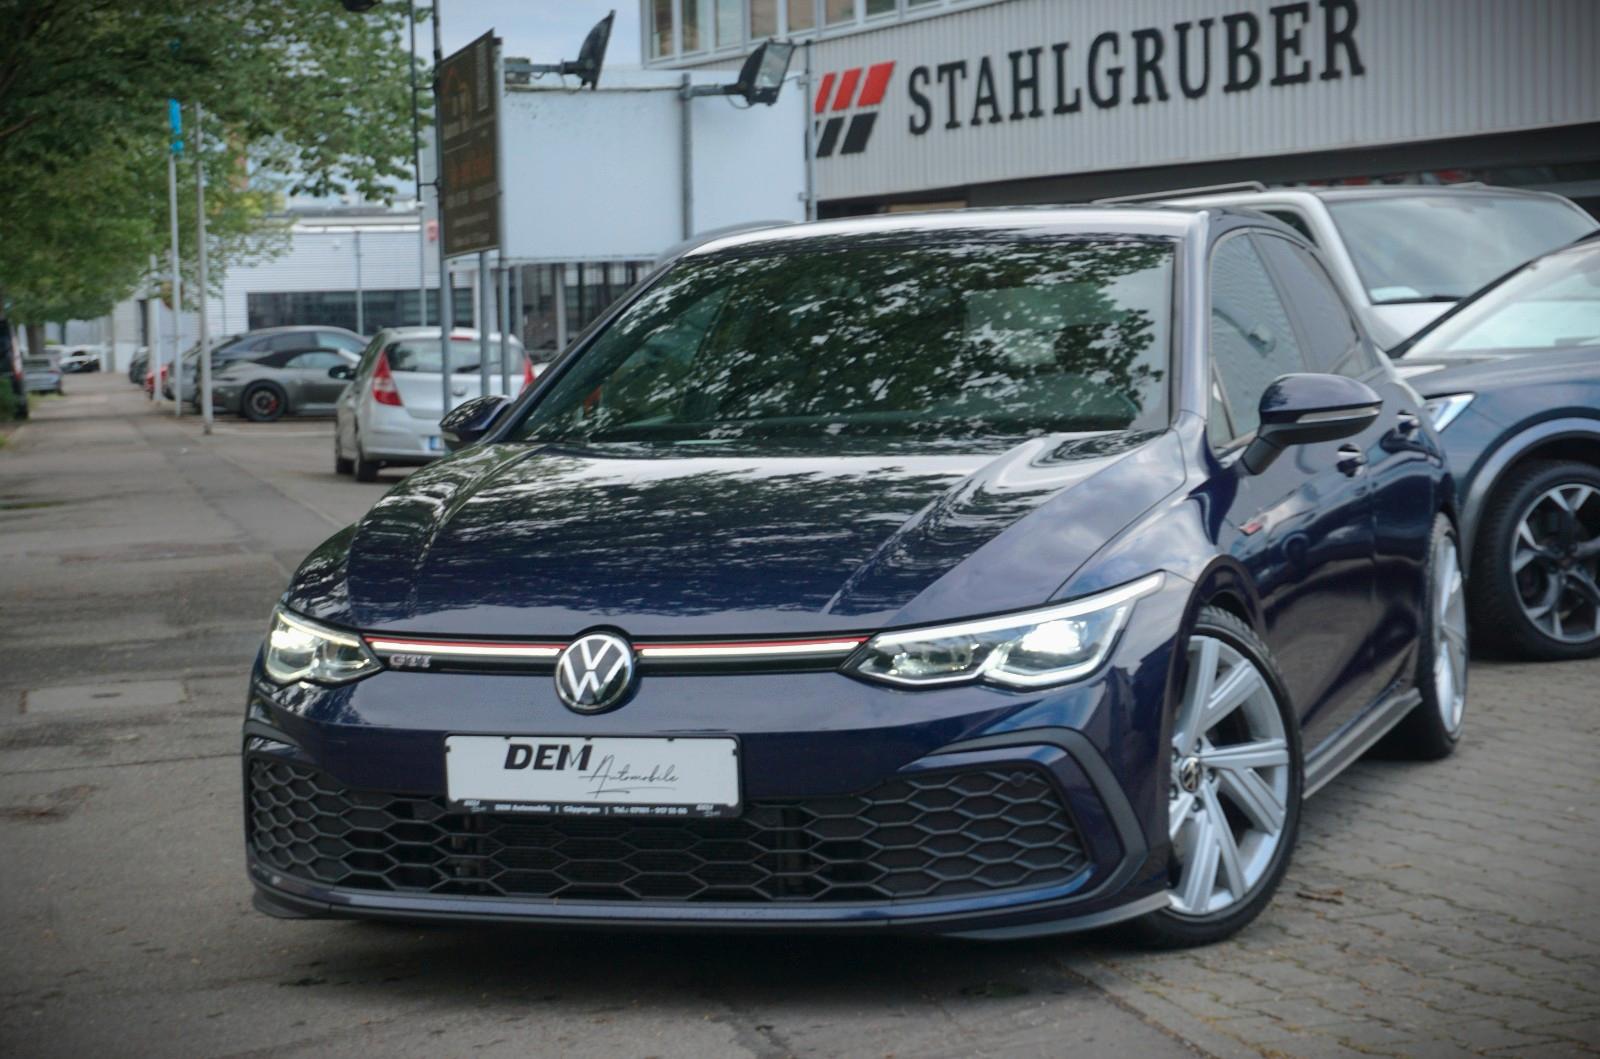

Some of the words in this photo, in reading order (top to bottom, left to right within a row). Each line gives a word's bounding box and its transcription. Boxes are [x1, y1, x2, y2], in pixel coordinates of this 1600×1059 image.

[907, 0, 1367, 136] STAHLGRUBER
[504, 743, 593, 771] DEM
[579, 754, 680, 798] Automobile
